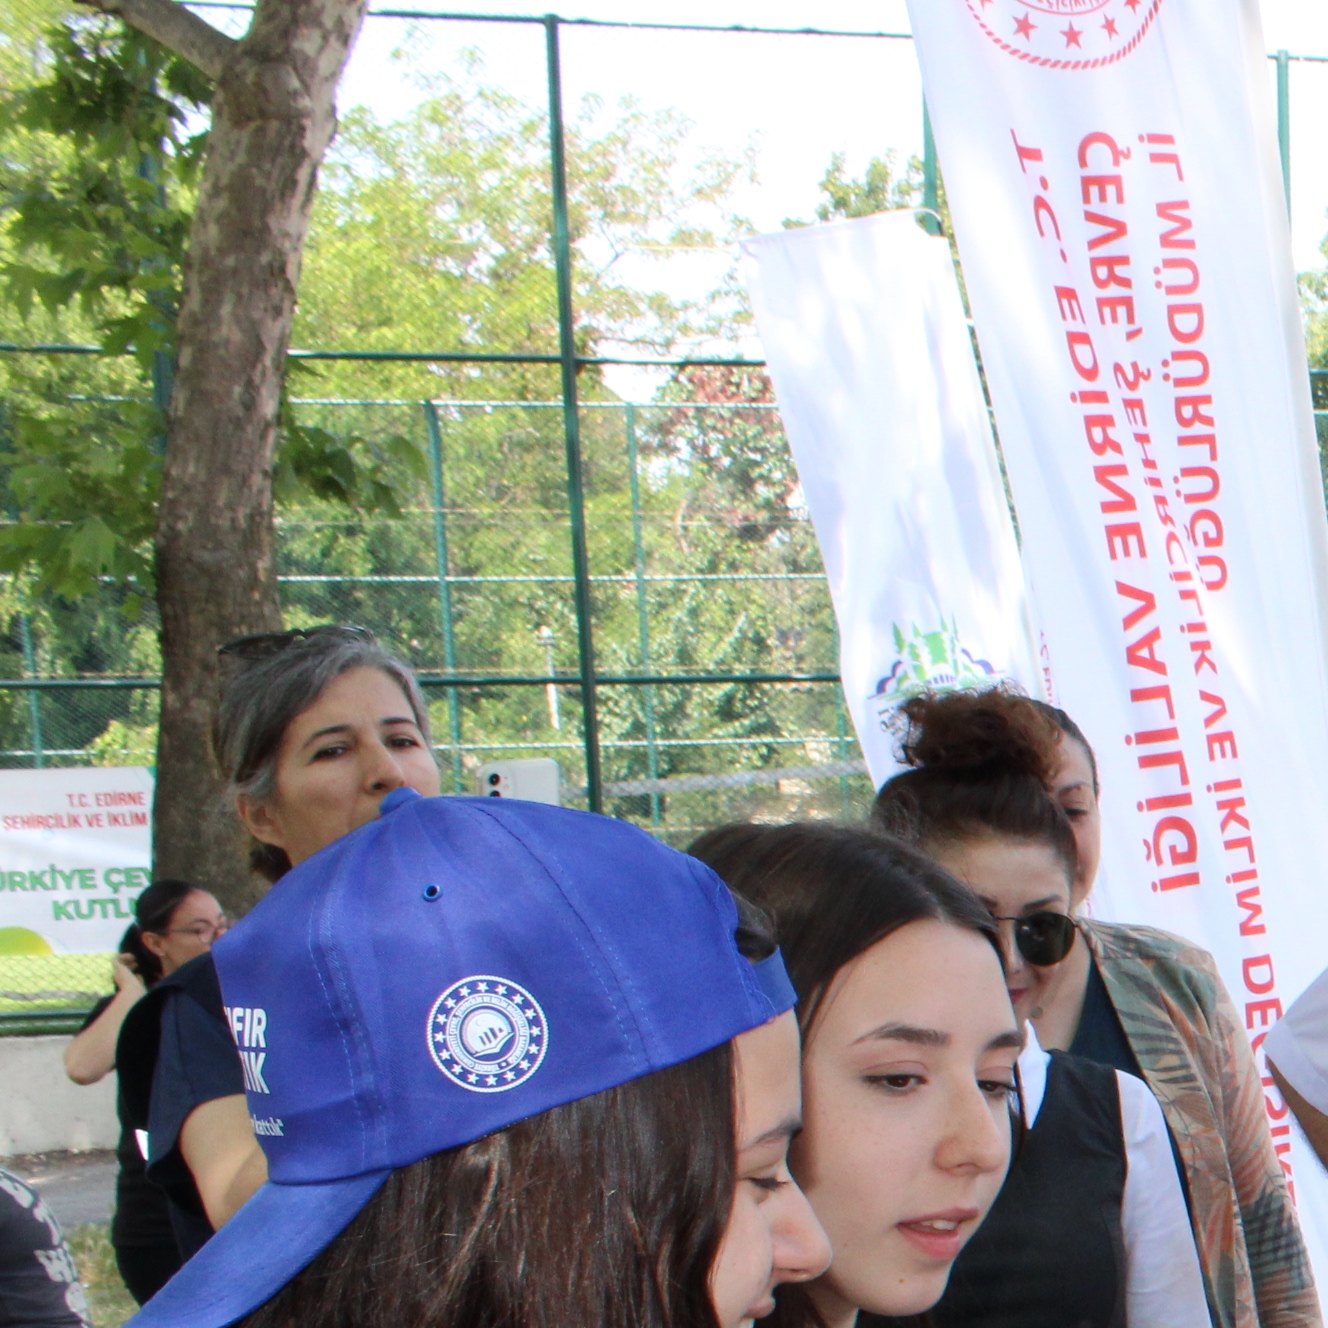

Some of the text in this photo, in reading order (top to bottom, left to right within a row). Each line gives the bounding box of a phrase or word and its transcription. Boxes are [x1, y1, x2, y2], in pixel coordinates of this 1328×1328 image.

[96, 790, 147, 808] EDİRNE
[86, 813, 104, 829] VE
[107, 811, 149, 827] İKLİM
